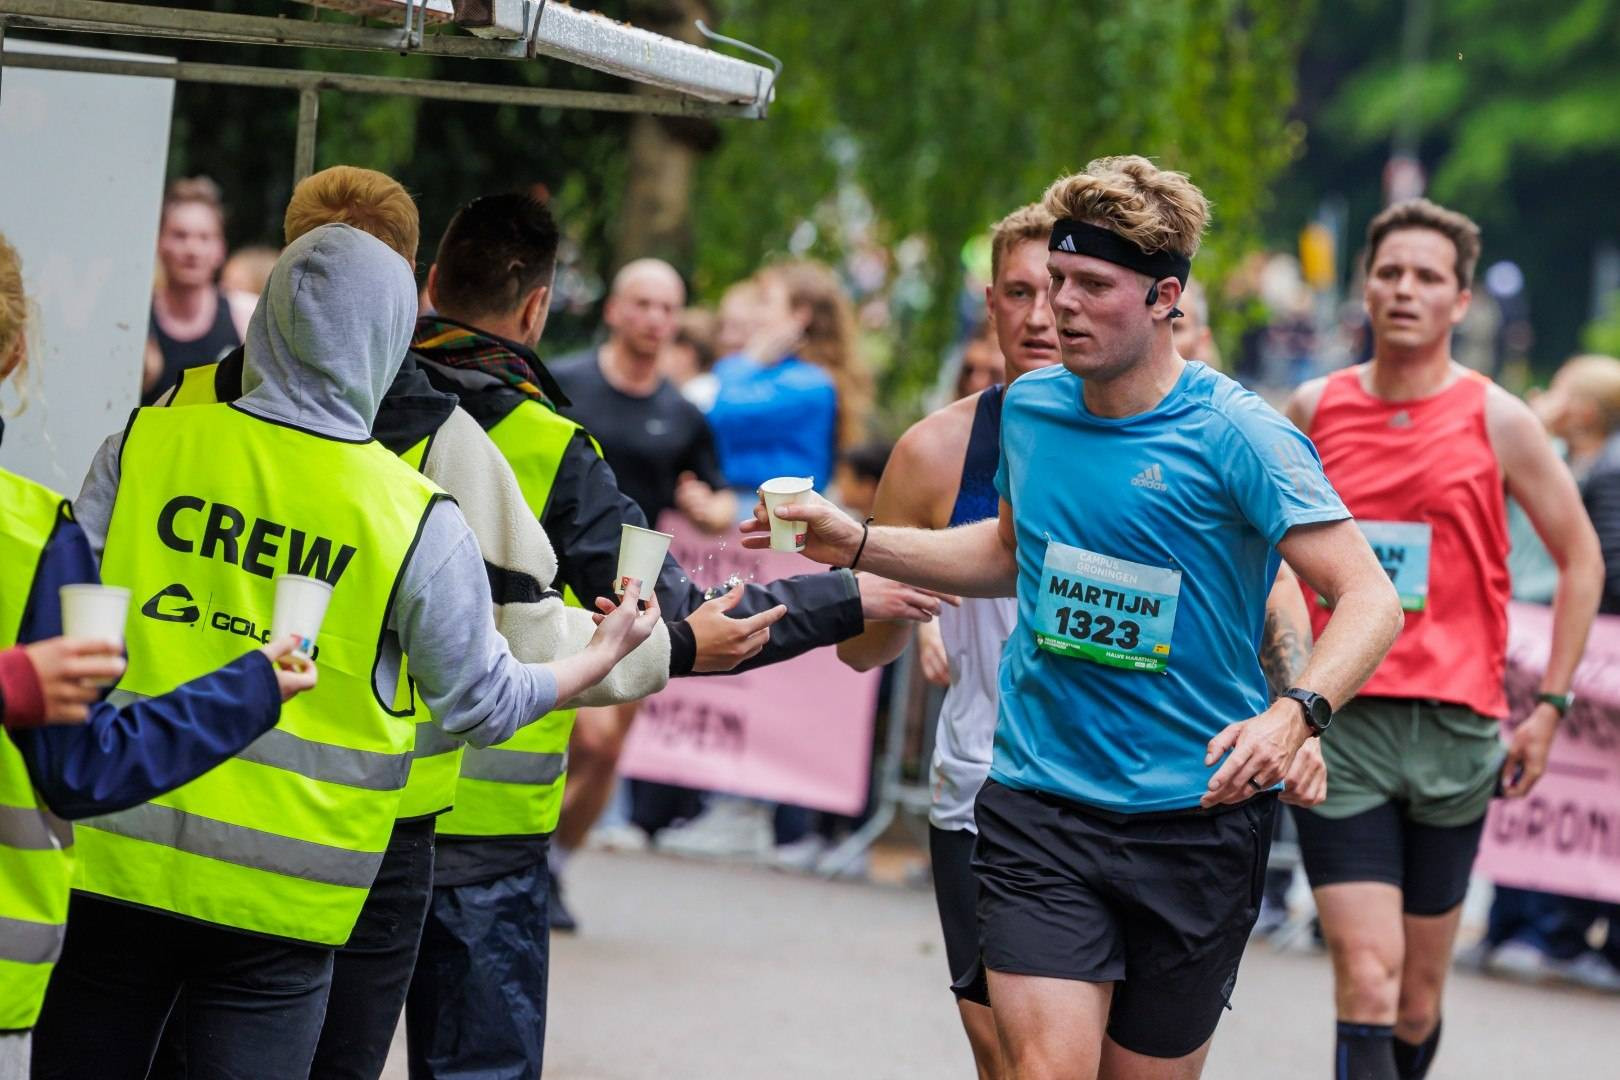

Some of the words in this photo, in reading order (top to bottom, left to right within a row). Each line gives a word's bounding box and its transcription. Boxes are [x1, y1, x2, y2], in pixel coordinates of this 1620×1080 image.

[1131, 477, 1167, 492] adidas
[157, 495, 357, 587] CREW
[1076, 562, 1138, 584] GRONINGEN
[1079, 553, 1120, 570] CAMPUS
[1049, 576, 1160, 617] MARTIJN
[1055, 606, 1140, 650] 1323
